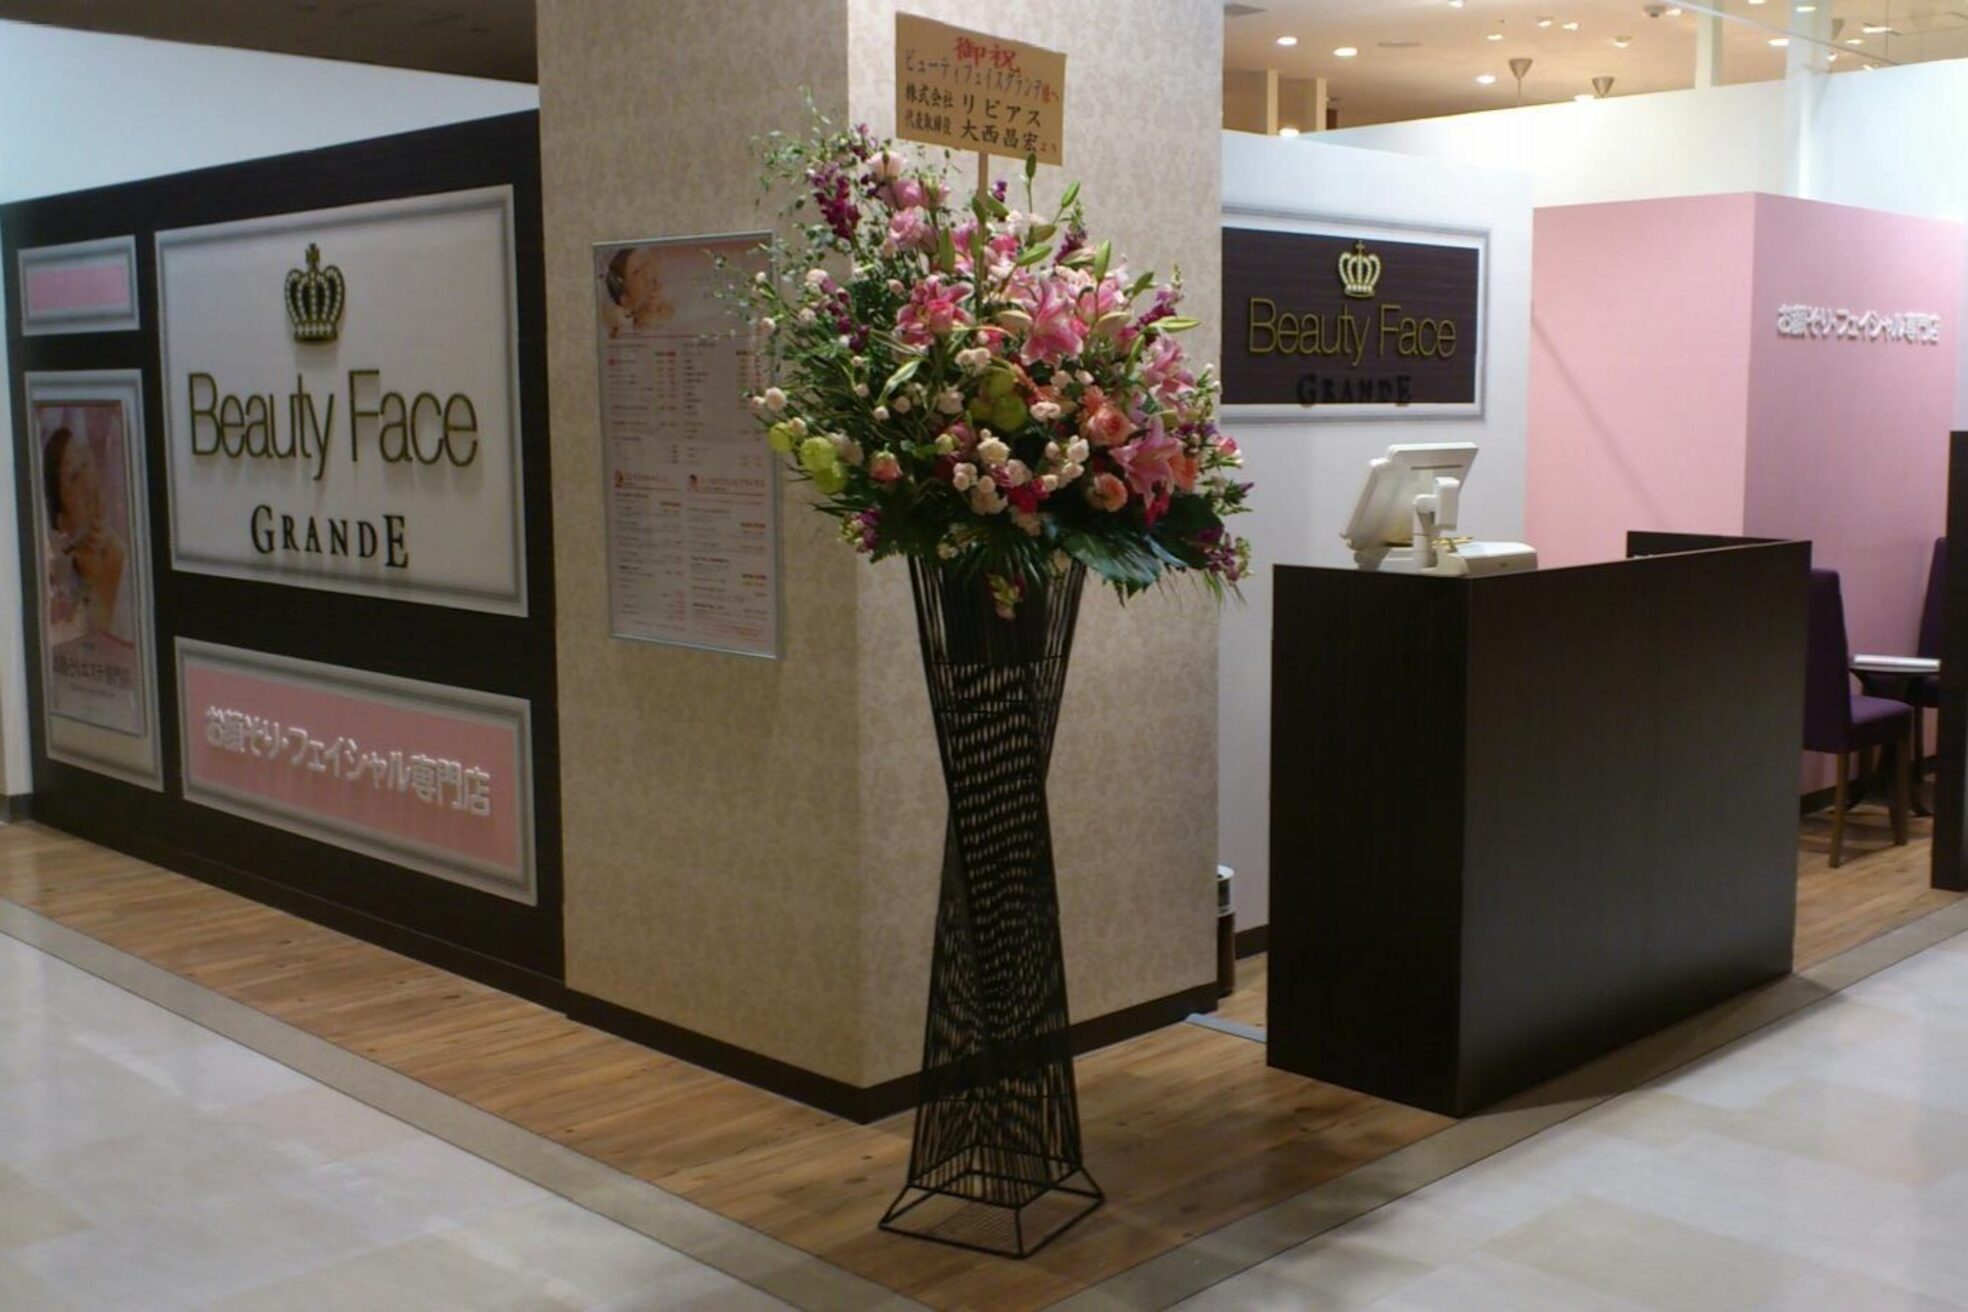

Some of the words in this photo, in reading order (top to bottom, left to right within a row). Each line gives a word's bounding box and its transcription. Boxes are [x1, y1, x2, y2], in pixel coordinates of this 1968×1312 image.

[1249, 297, 1370, 367] Beauty
[1380, 303, 1457, 358] Face
[1298, 373, 1412, 407] GRANDE
[188, 372, 335, 481] Beauty
[348, 368, 479, 468] Face
[250, 504, 409, 569] GRANDE
